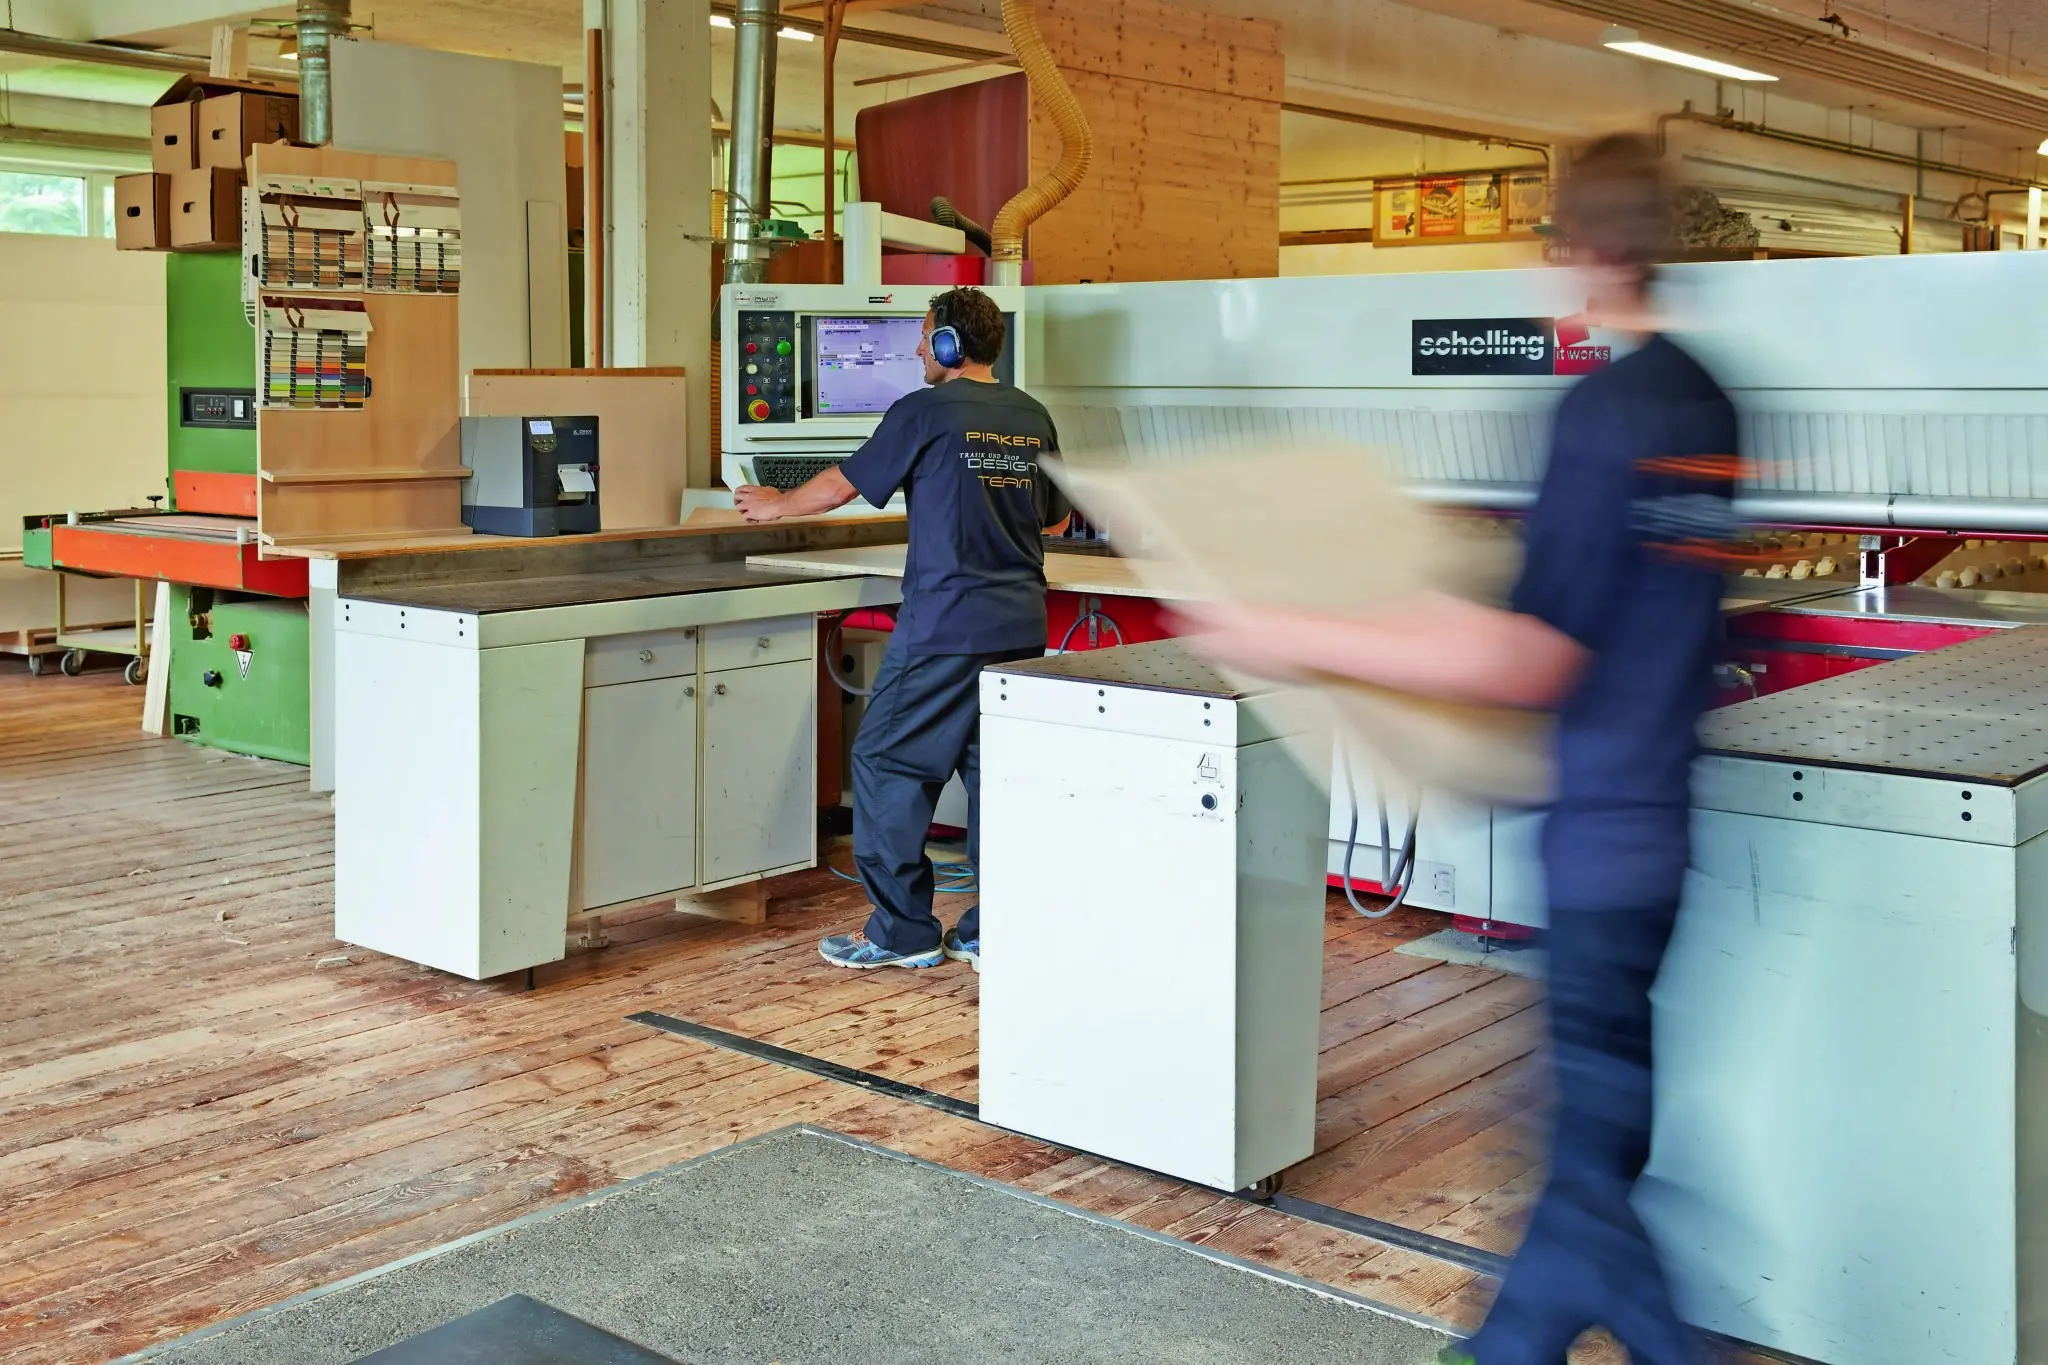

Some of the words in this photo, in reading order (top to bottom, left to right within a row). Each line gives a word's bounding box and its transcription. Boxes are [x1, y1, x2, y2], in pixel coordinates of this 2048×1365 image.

[1419, 330, 1545, 361] schelling
[1555, 347, 1565, 360] it
[1567, 346, 1609, 360] works
[966, 431, 1041, 448] PIRKER
[967, 458, 1038, 473] DESIGN
[977, 475, 1032, 489] TEAM
